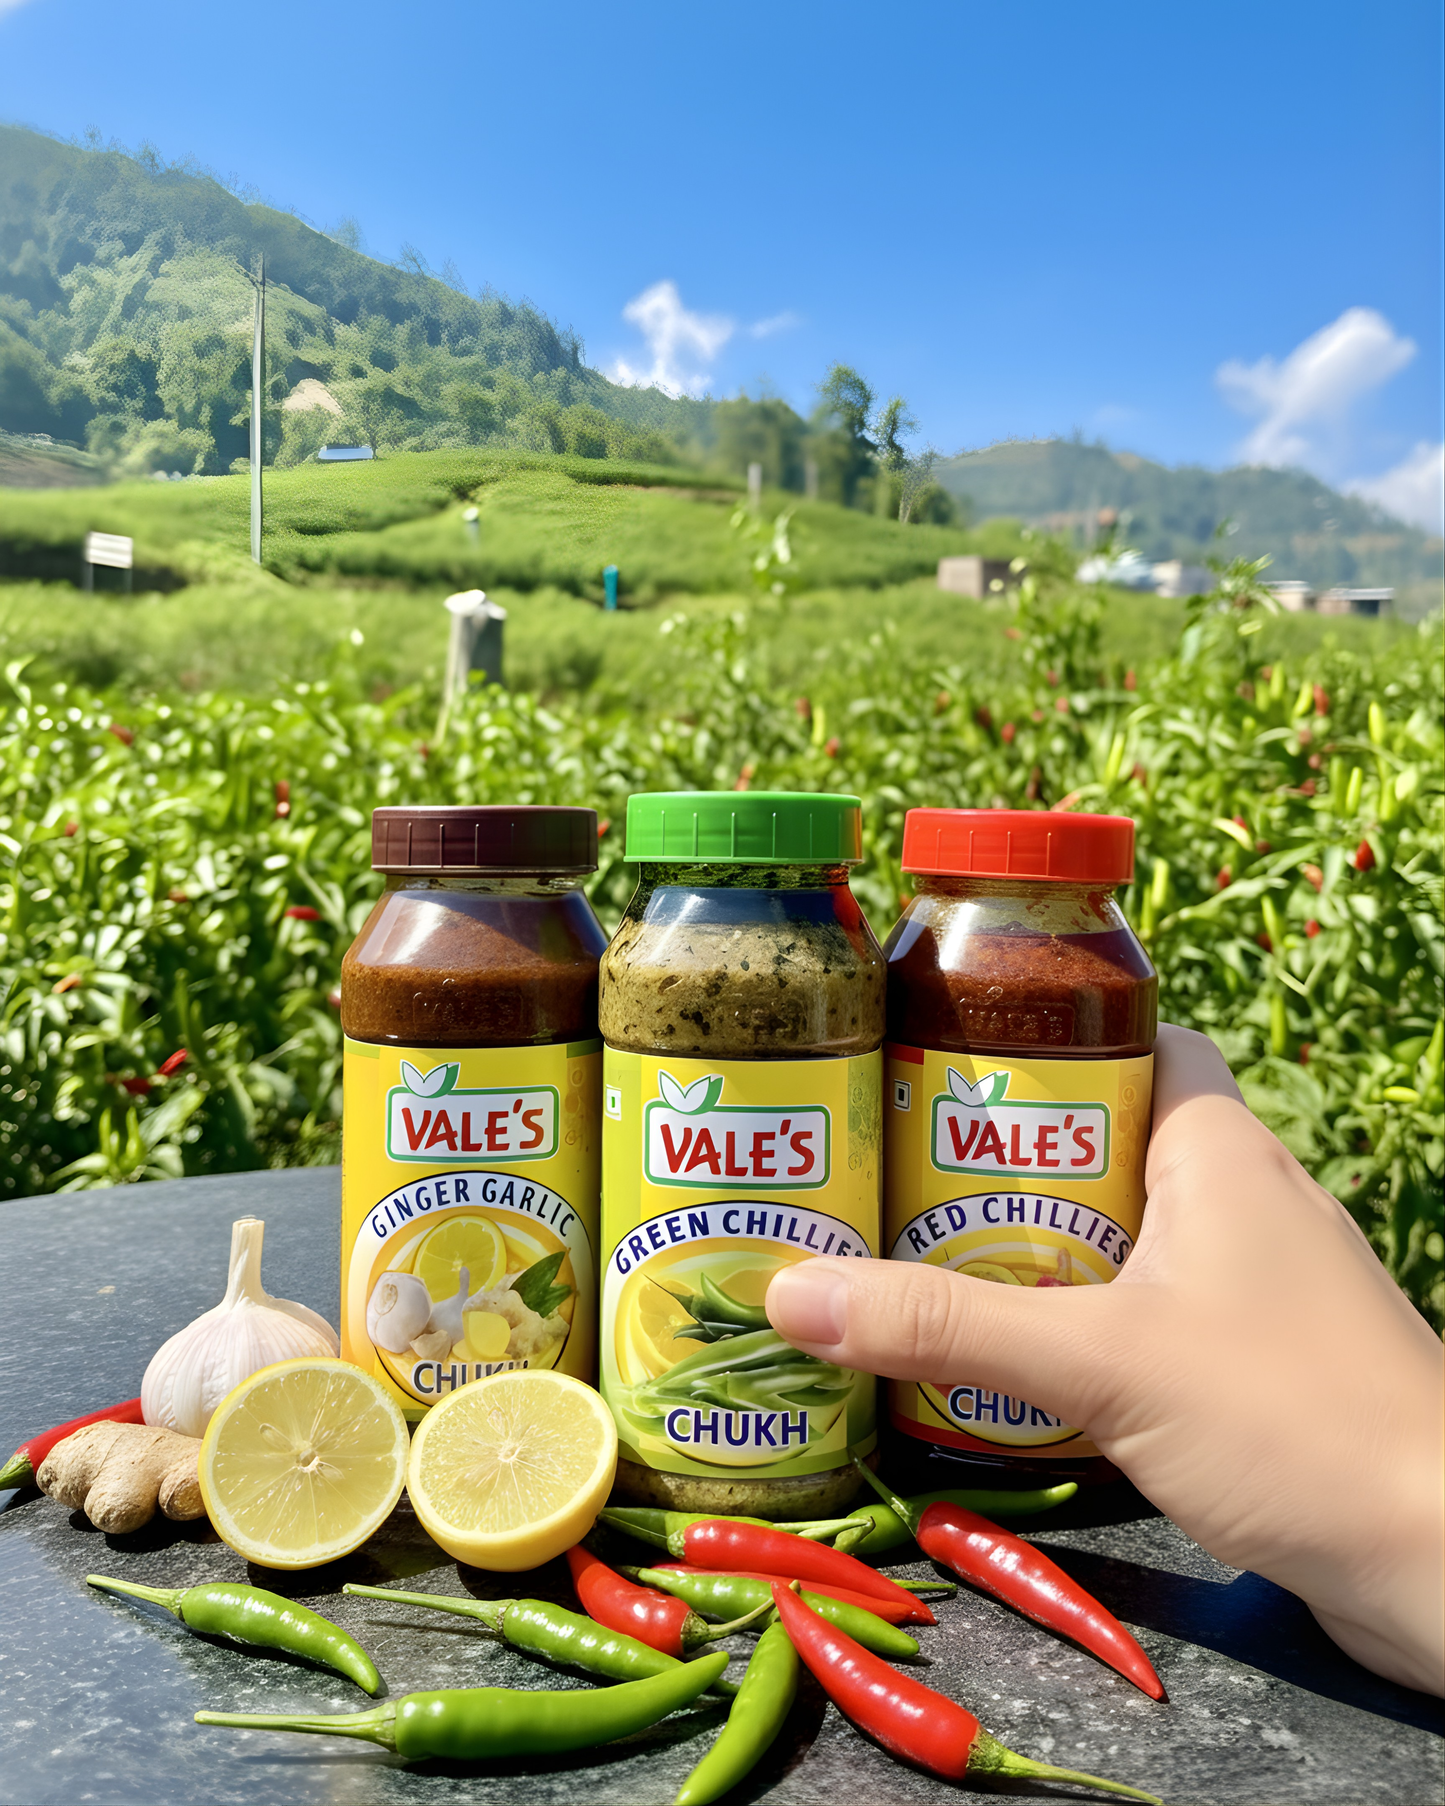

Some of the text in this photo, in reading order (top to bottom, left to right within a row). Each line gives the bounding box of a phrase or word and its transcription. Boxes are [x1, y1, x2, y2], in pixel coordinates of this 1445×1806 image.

[402, 1099, 544, 1151] VALE'S
[660, 1119, 815, 1177] VALE'S
[947, 1114, 1096, 1167] VALE'S
[372, 1178, 575, 1238] GINGER GARLIC
[906, 1197, 1130, 1265] RED CHILLIES
[615, 1211, 710, 1274] GREEN
[413, 1361, 529, 1394] CHU
[665, 1408, 809, 1446] CHUKH
[949, 1387, 1061, 1427] CHUK
